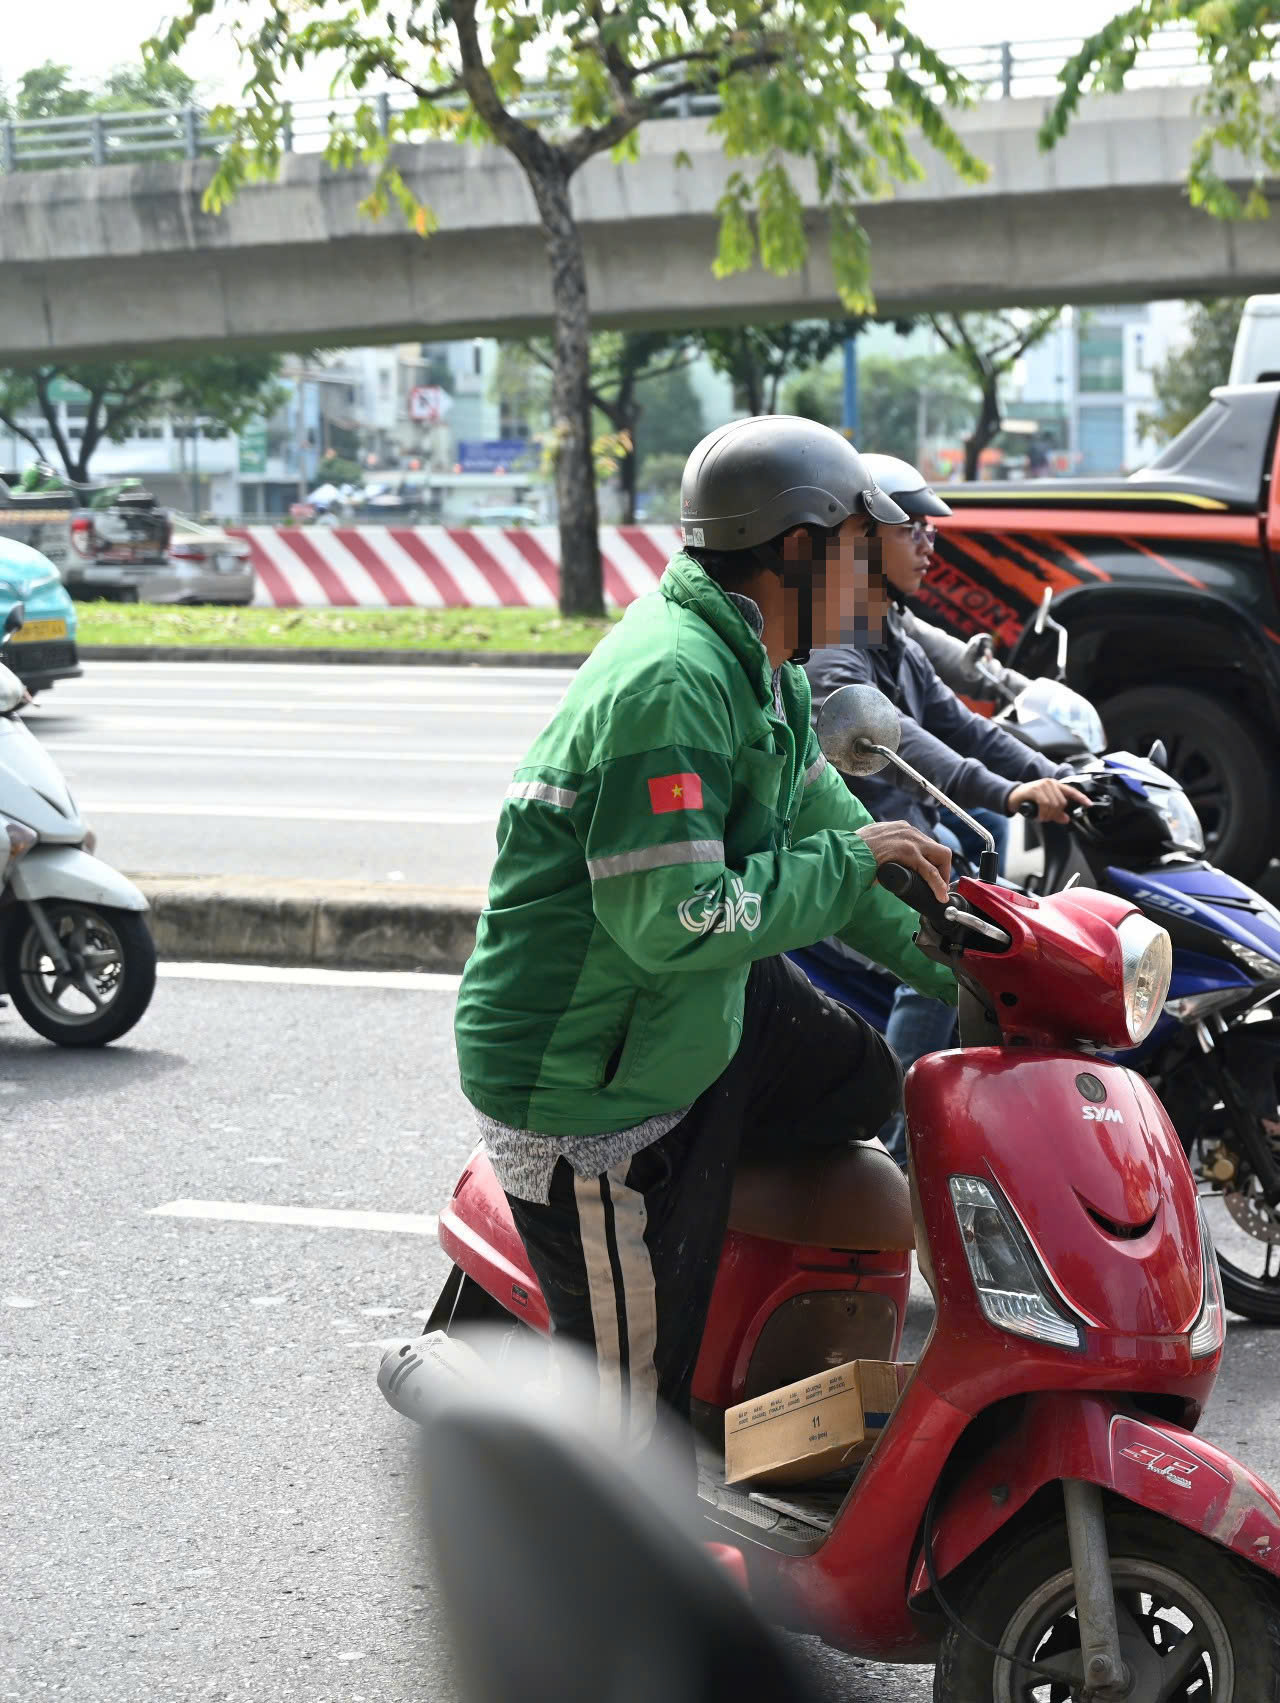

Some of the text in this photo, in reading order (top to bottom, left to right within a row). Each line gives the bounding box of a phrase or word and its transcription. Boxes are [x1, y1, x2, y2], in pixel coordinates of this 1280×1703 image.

[1134, 889, 1196, 915] 150
[1082, 1105, 1124, 1124] SYM
[812, 1415, 820, 1428] 11
